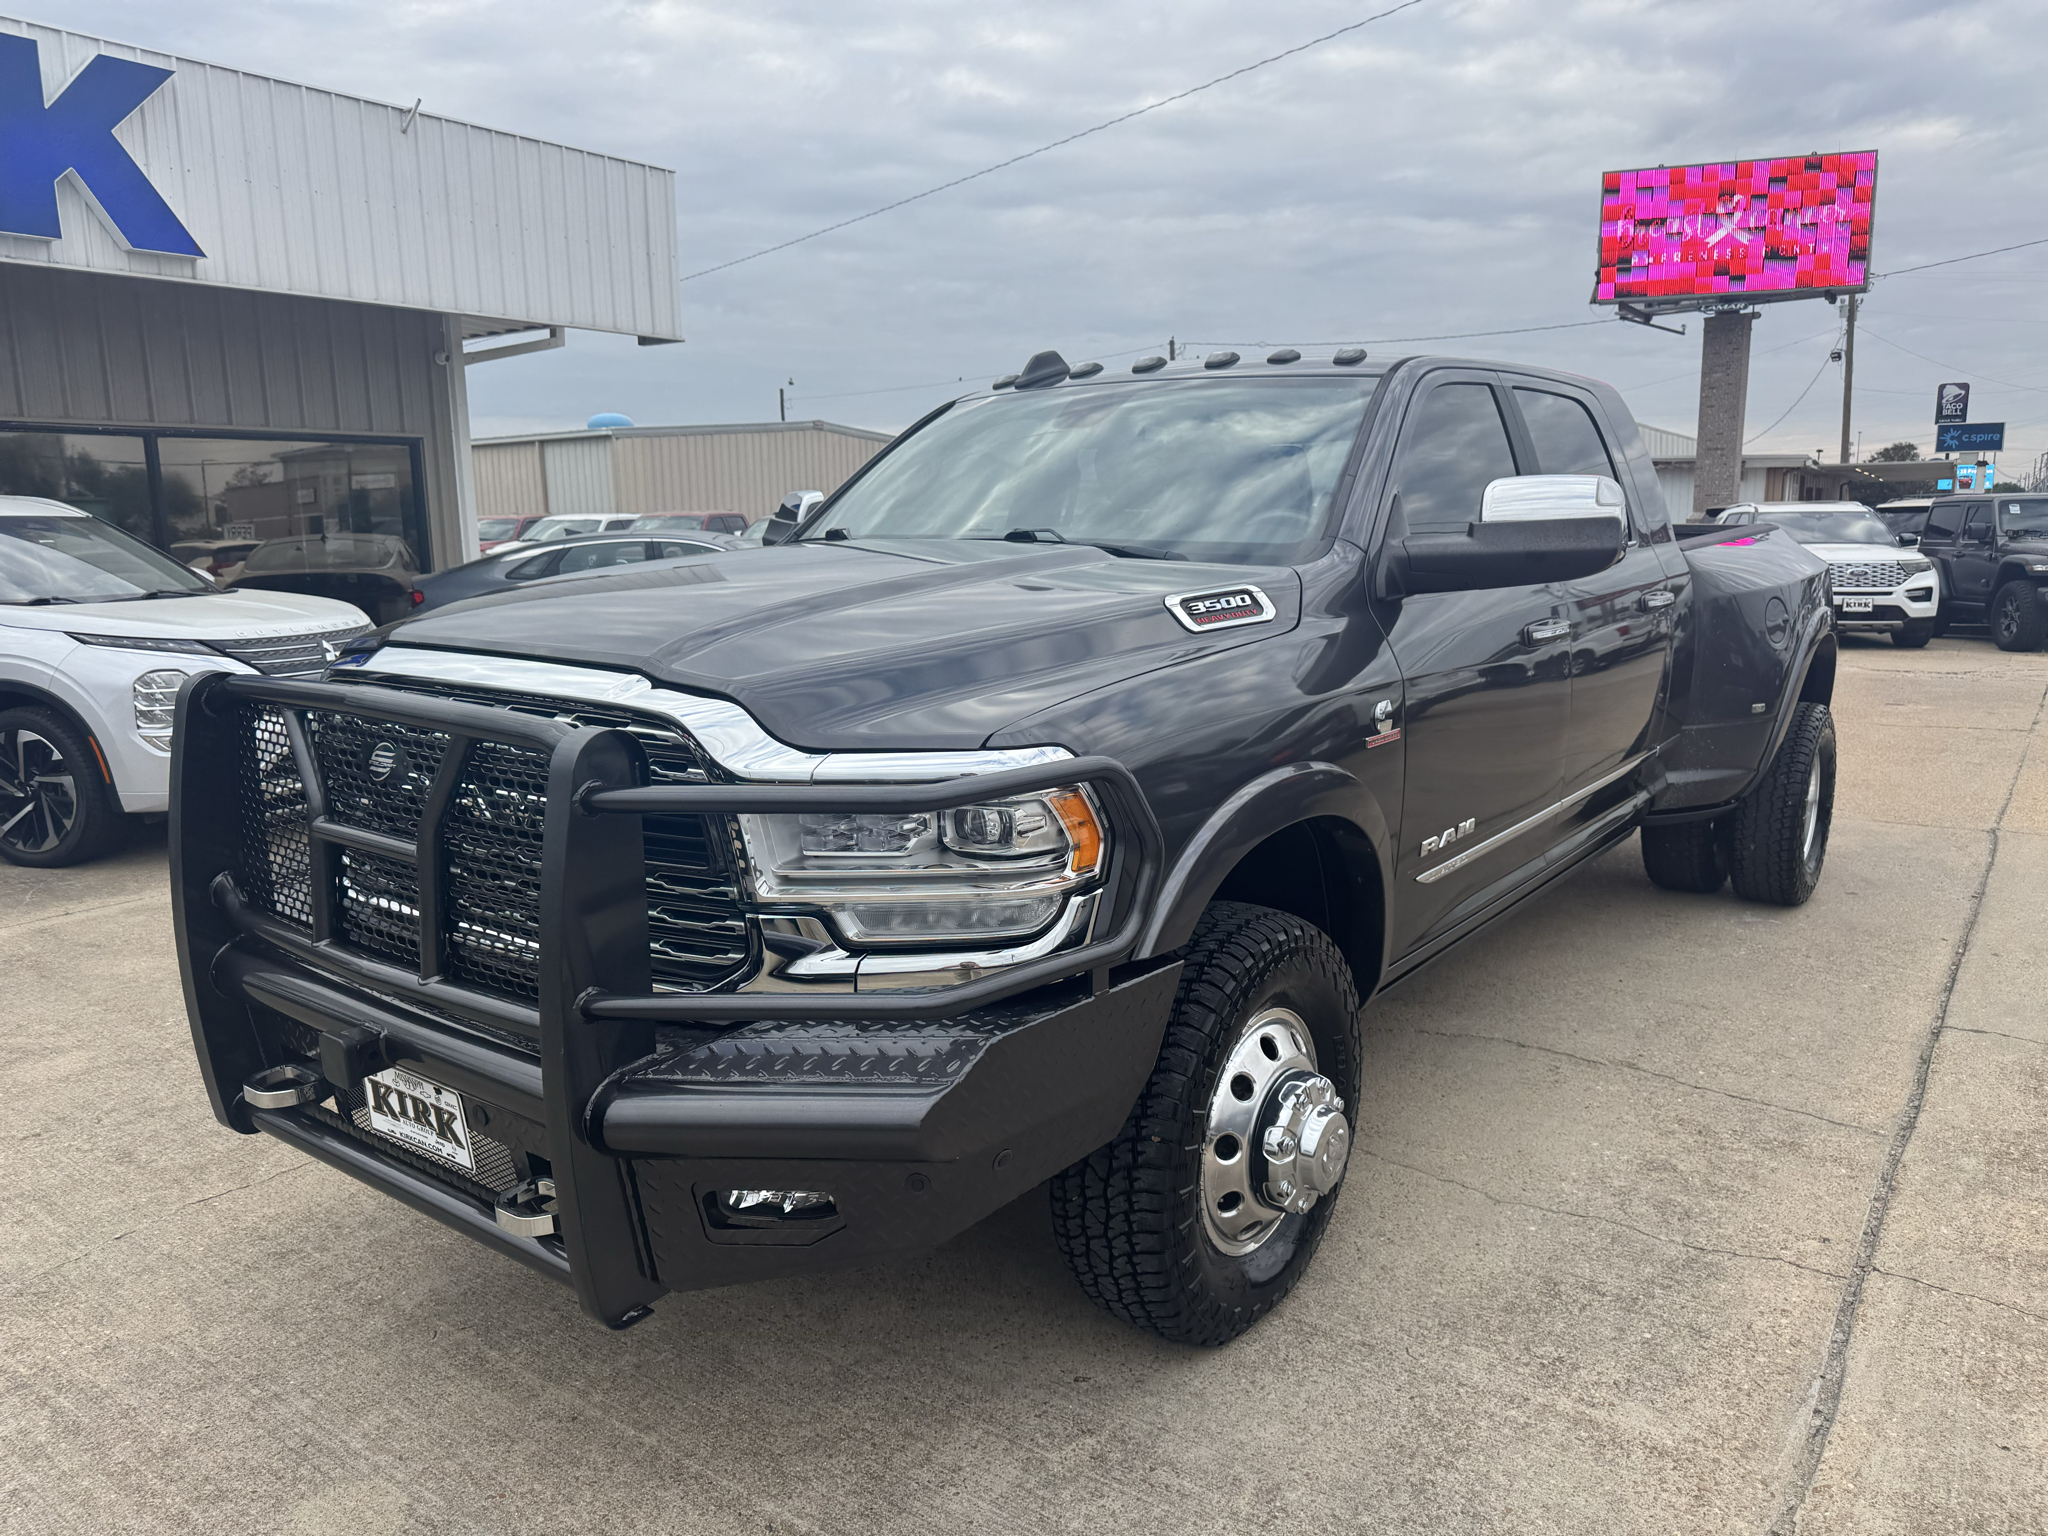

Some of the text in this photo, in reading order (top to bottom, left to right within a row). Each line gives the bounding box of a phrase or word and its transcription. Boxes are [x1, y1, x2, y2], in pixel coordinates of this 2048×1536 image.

[1700, 302, 1746, 311] LAMAR
[1187, 594, 1252, 614] 3500
[1845, 601, 1871, 609] KIRK
[1196, 608, 1258, 624] HEAVY DUTY
[1419, 817, 1476, 857] RAM
[367, 1077, 466, 1150] KIRK
